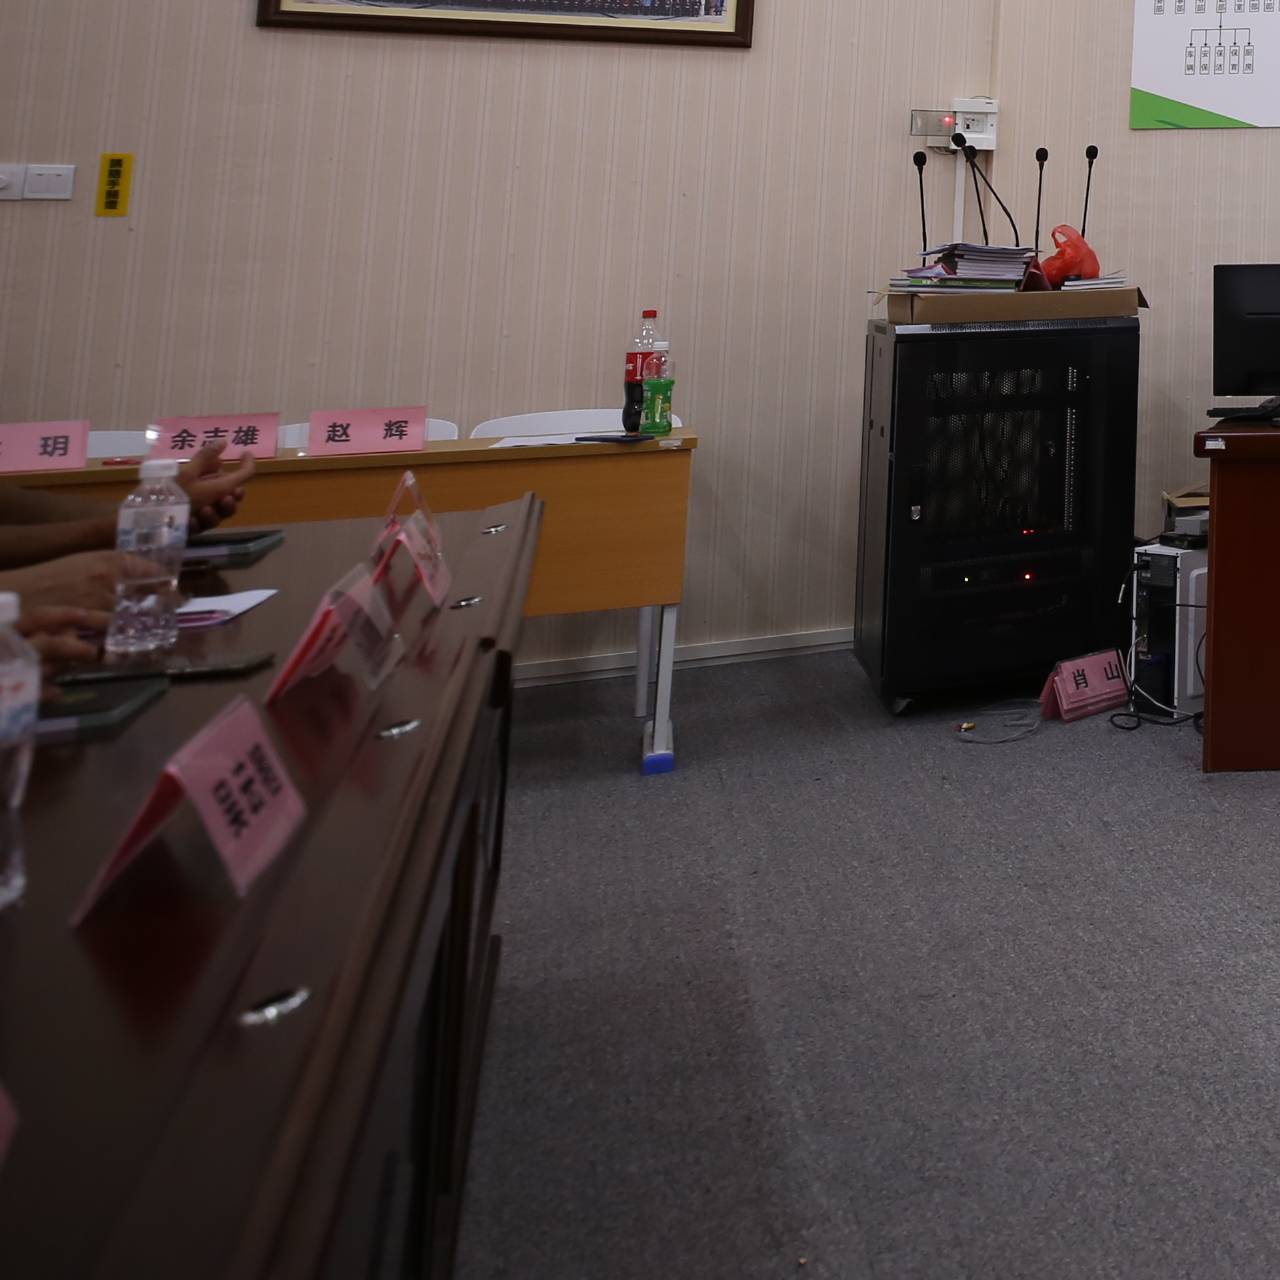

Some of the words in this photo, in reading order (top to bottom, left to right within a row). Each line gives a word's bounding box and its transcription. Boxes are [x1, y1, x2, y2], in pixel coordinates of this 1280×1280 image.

[171, 426, 260, 451] 余志雄
[326, 419, 409, 443] 赵辉
